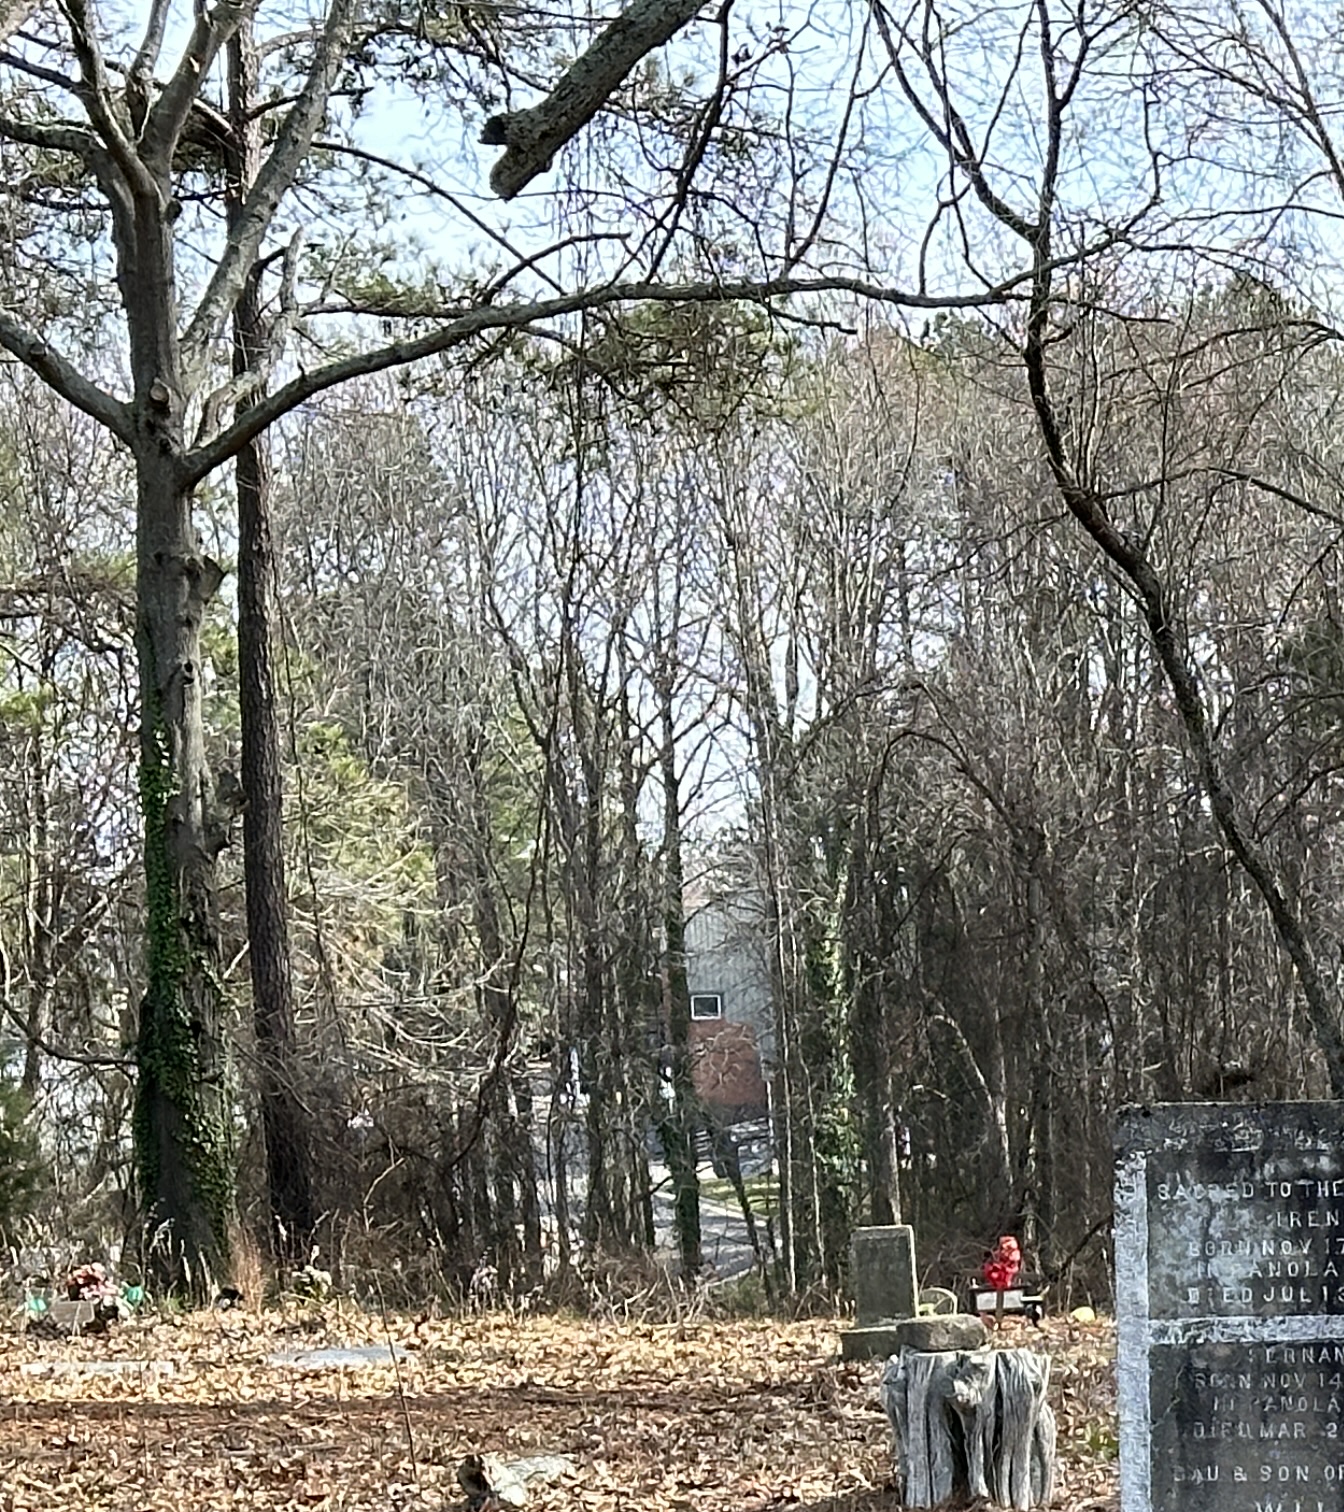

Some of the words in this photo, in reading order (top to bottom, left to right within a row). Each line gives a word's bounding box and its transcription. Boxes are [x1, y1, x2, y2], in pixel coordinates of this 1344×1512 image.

[1265, 1180, 1292, 1198] TO
[1262, 1238, 1312, 1256] NOV
[1231, 1259, 1338, 1279] ANOLA
[1263, 1285, 1311, 1303] JUL
[1263, 1372, 1307, 1390] NOV
[1319, 1372, 1343, 1391] 14
[1259, 1420, 1307, 1439] MAR
[1325, 1421, 1338, 1439] 2
[1233, 1465, 1248, 1482] &
[1260, 1464, 1310, 1483] SON
